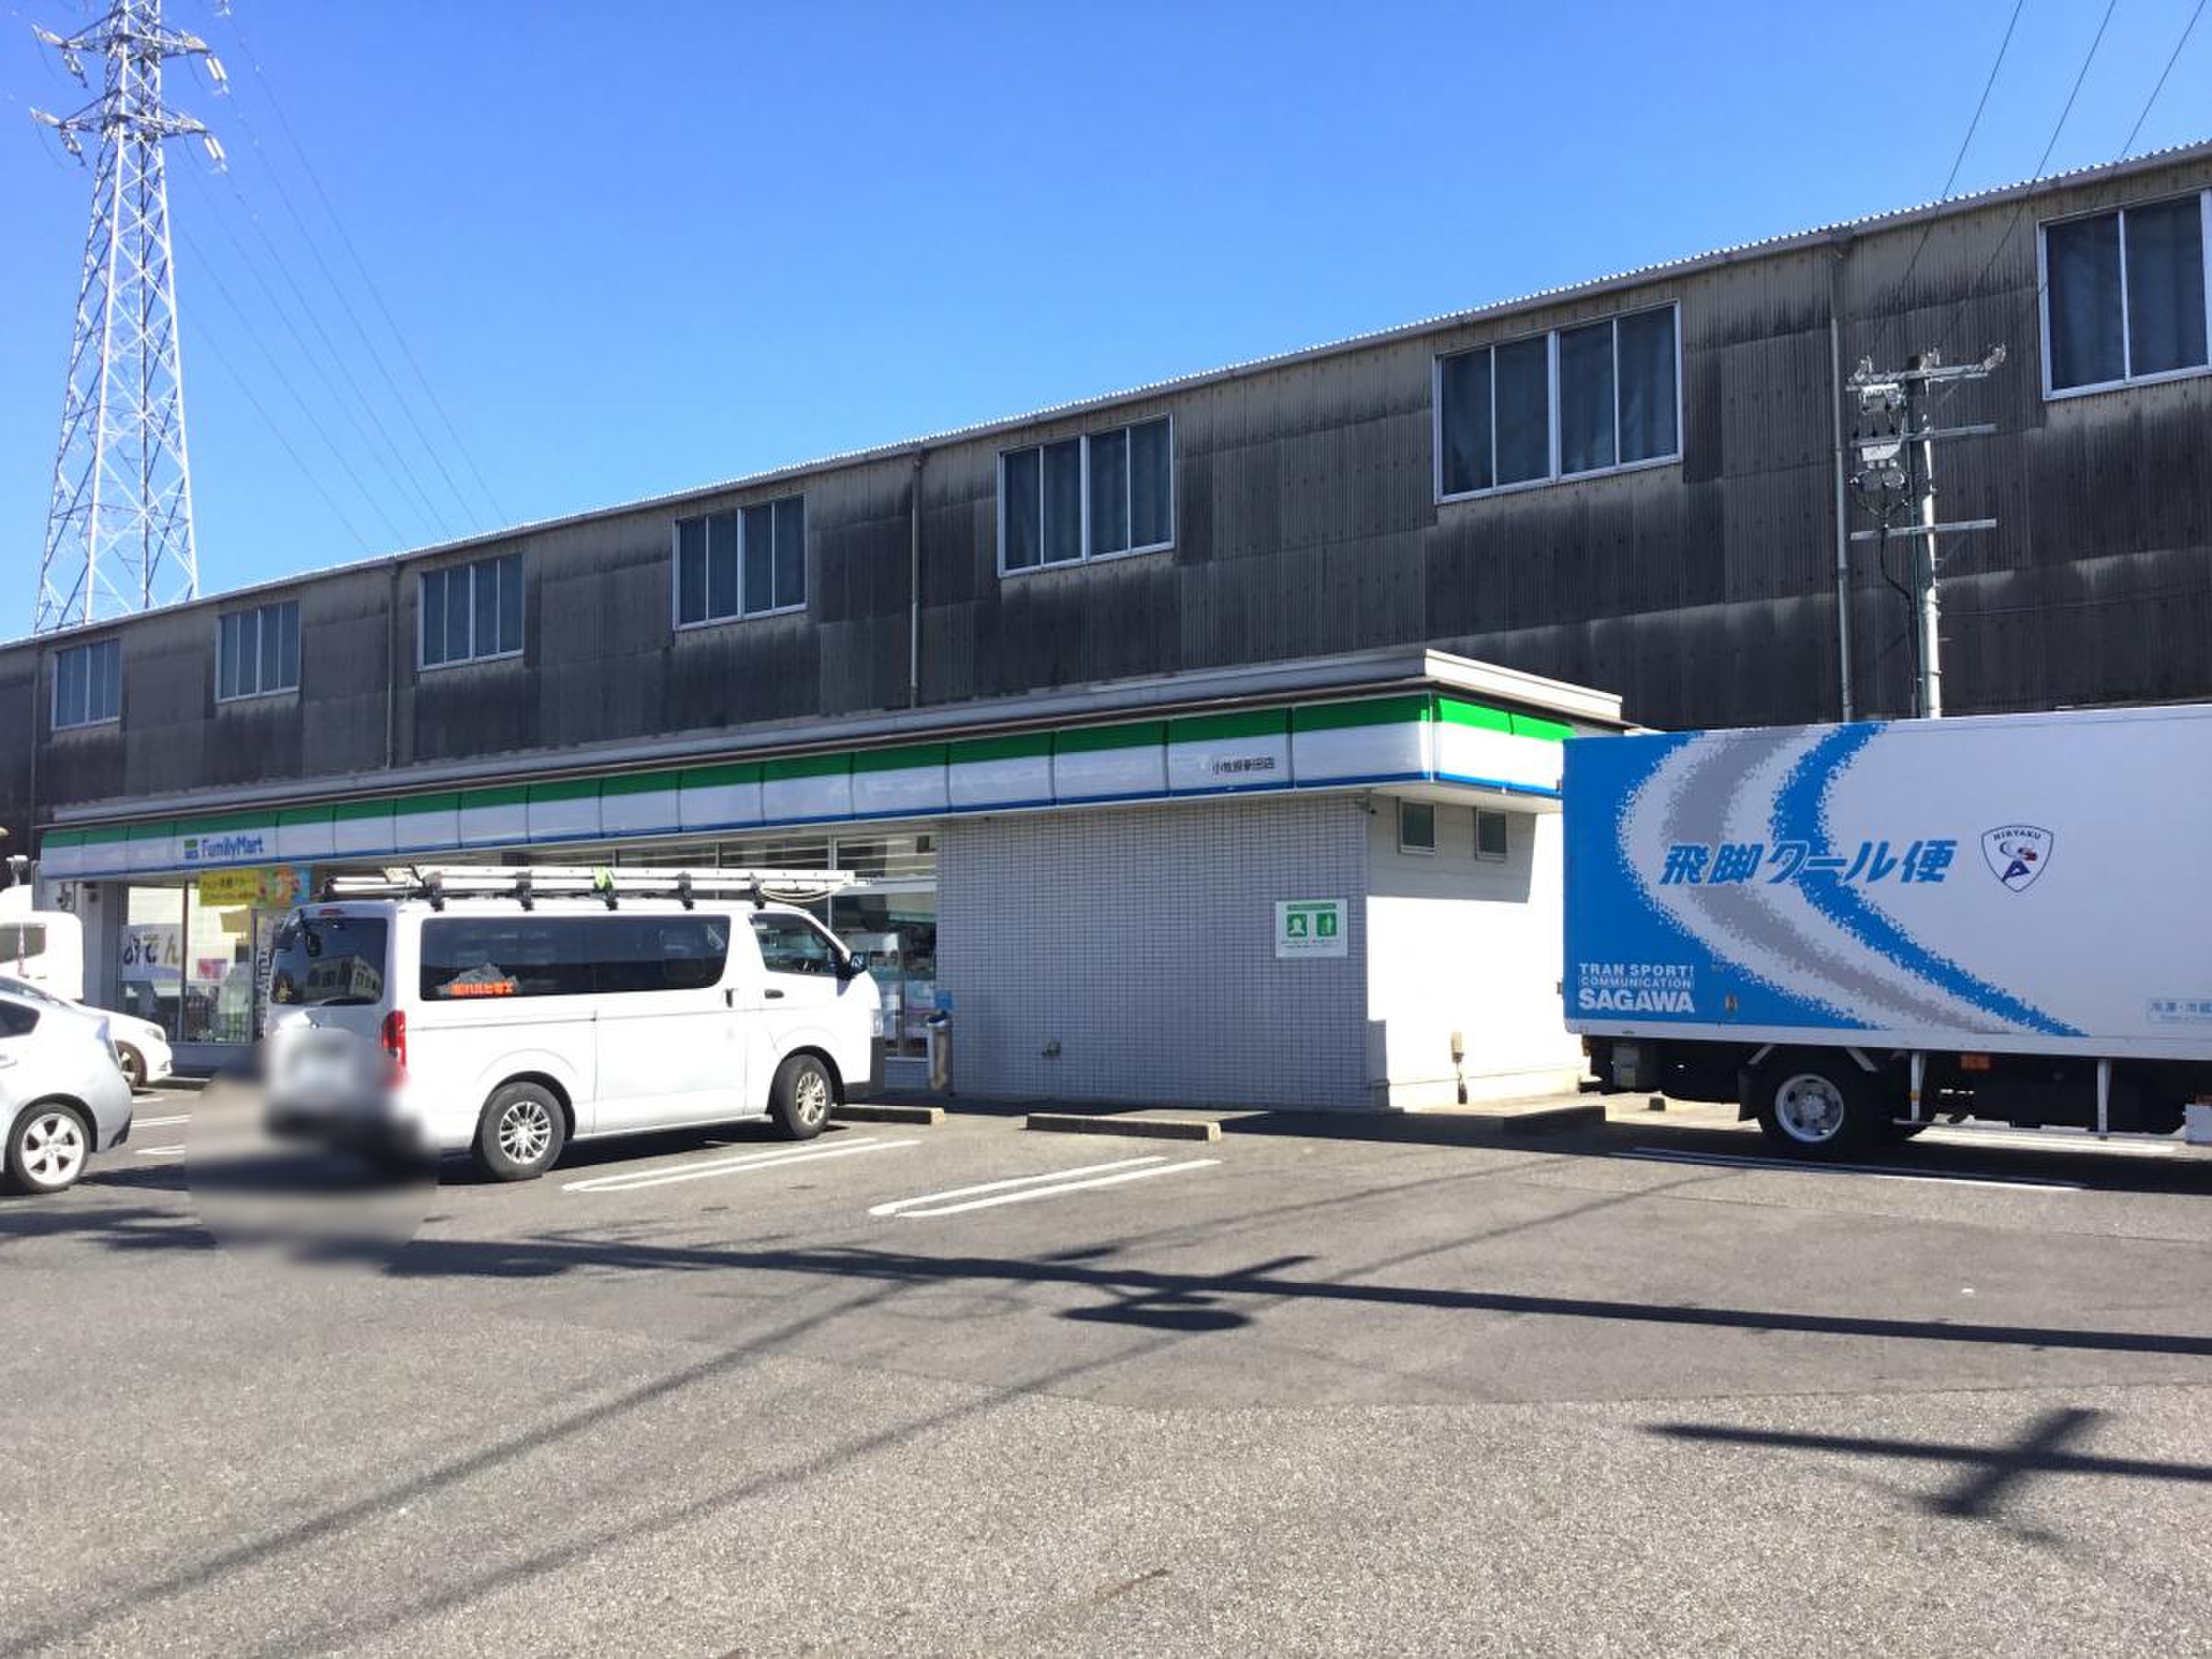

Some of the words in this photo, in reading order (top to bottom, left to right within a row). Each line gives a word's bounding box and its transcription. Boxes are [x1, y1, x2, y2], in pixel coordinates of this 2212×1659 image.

[202, 835, 264, 856] FamilyMart
[1659, 840, 1958, 885] 飛脚クール便
[1580, 975, 1691, 989] COMMUNICATION
[1578, 987, 1695, 1013] SAGAWA
